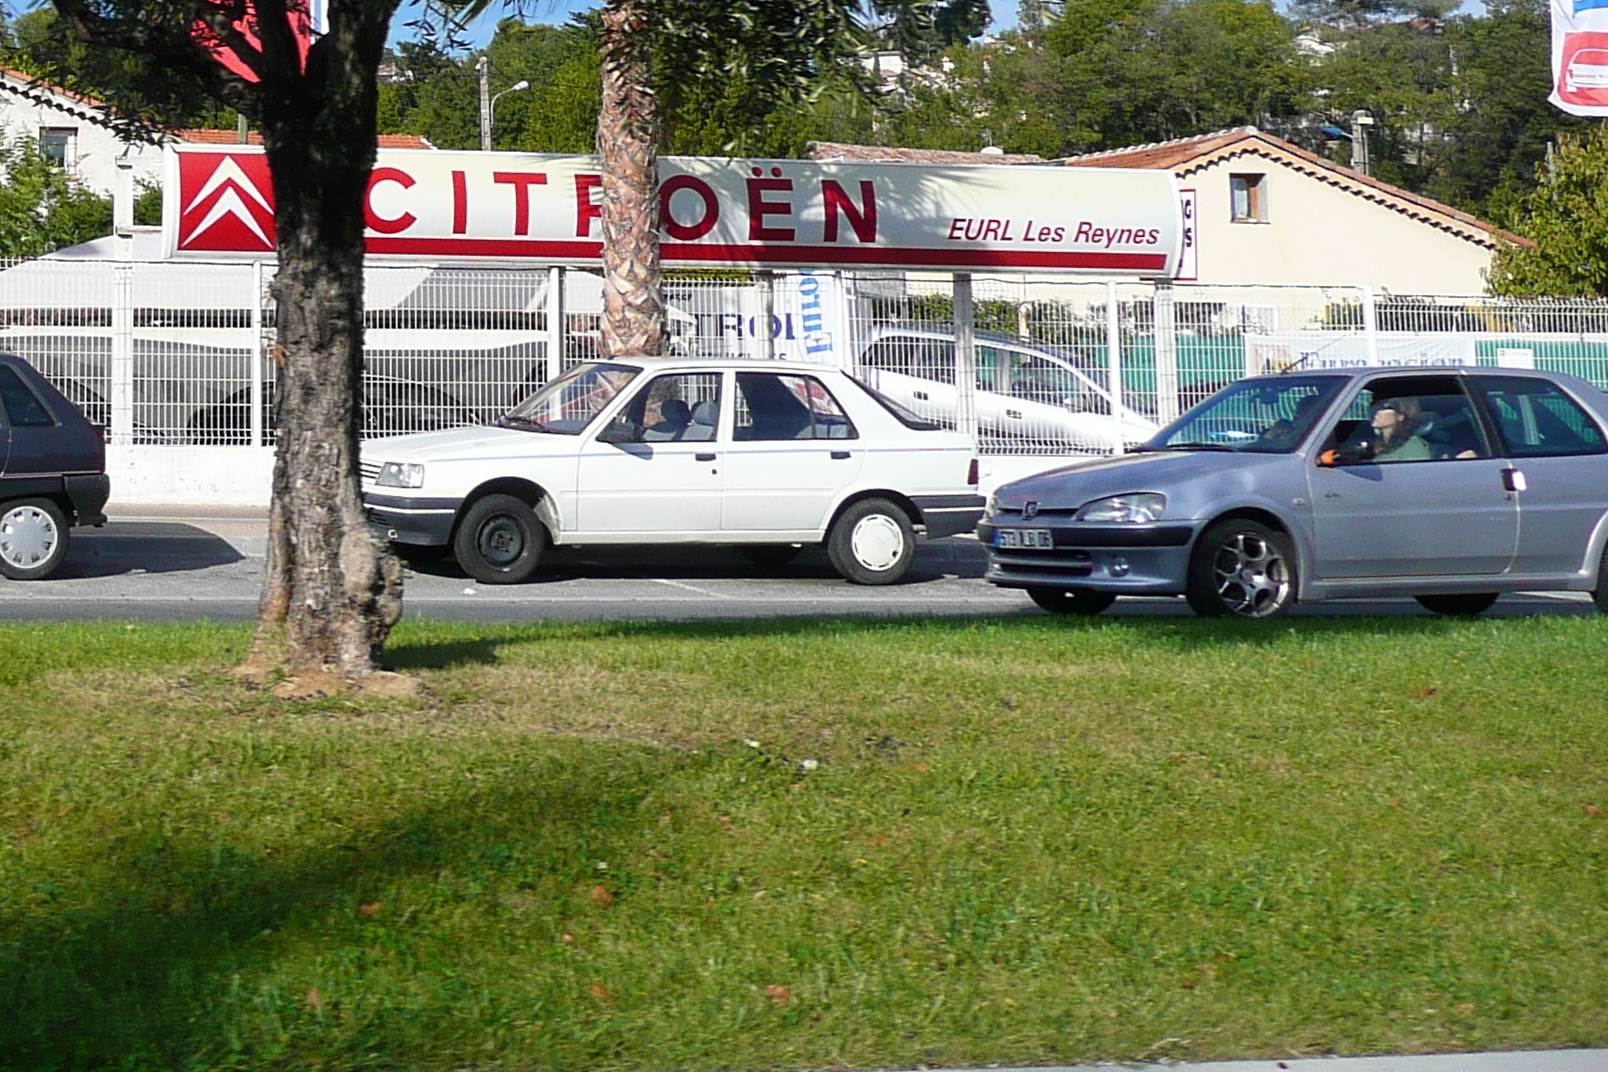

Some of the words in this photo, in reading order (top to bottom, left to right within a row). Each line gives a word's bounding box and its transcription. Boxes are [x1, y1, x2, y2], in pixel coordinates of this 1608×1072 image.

[947, 218, 1014, 242] EURL
[1023, 220, 1066, 243] Les
[1074, 221, 1161, 248] Reynes
